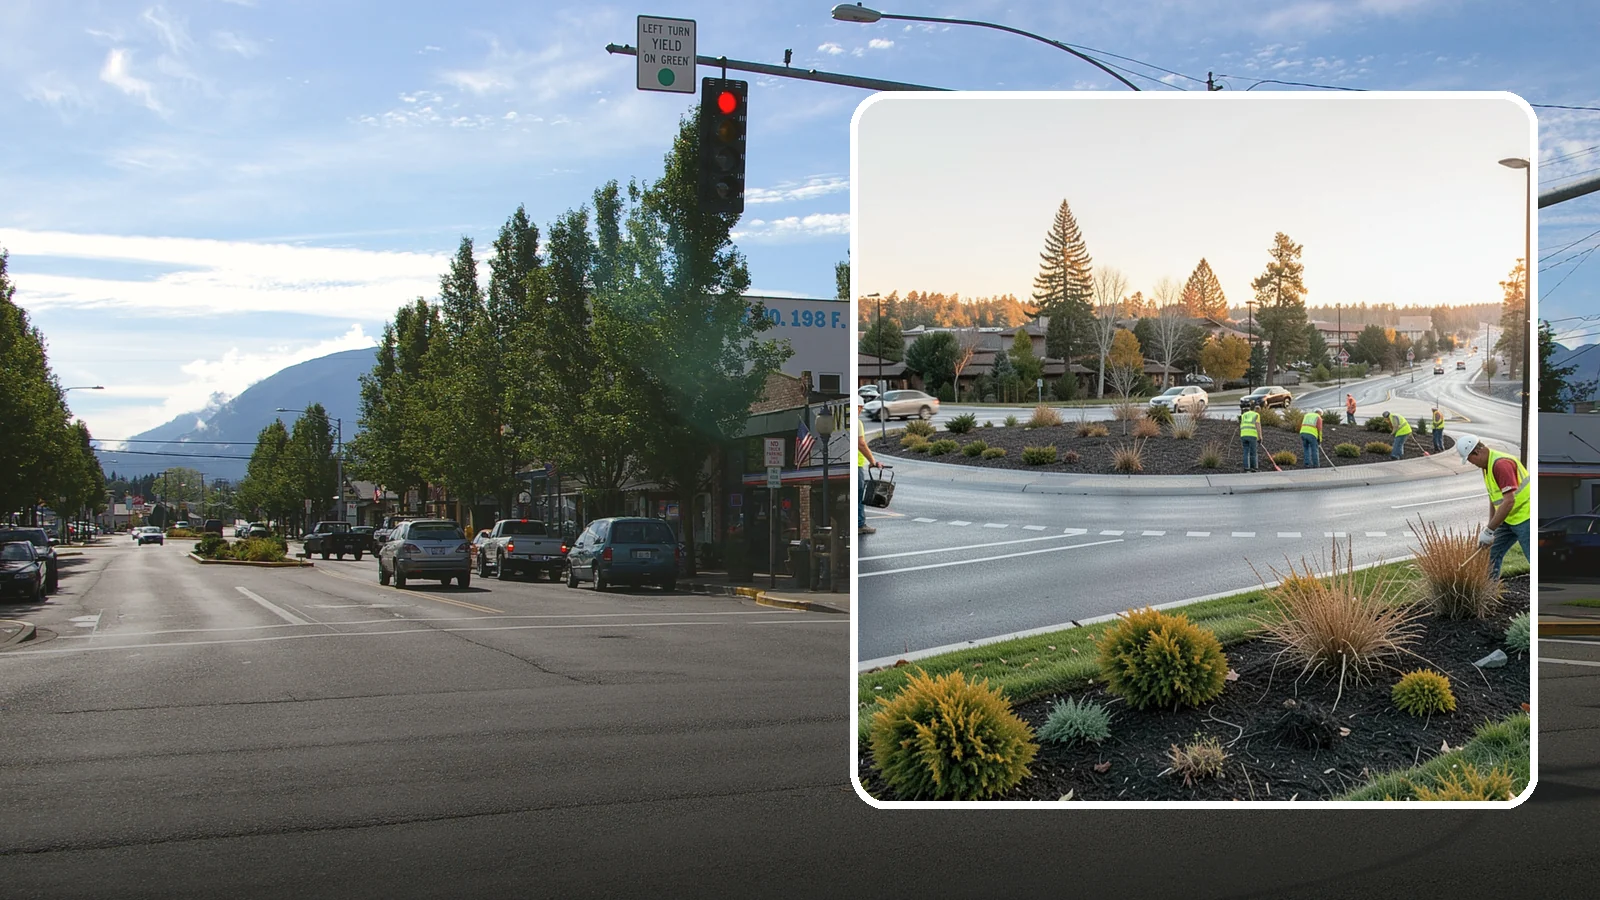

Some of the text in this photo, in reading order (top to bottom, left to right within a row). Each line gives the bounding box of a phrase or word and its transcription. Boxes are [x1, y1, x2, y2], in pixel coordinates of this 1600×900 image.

[643, 24, 690, 36] LEFT TURN
[652, 38, 682, 52] YIELD
[644, 54, 689, 66] ON GREEN
[791, 310, 826, 328] 198
